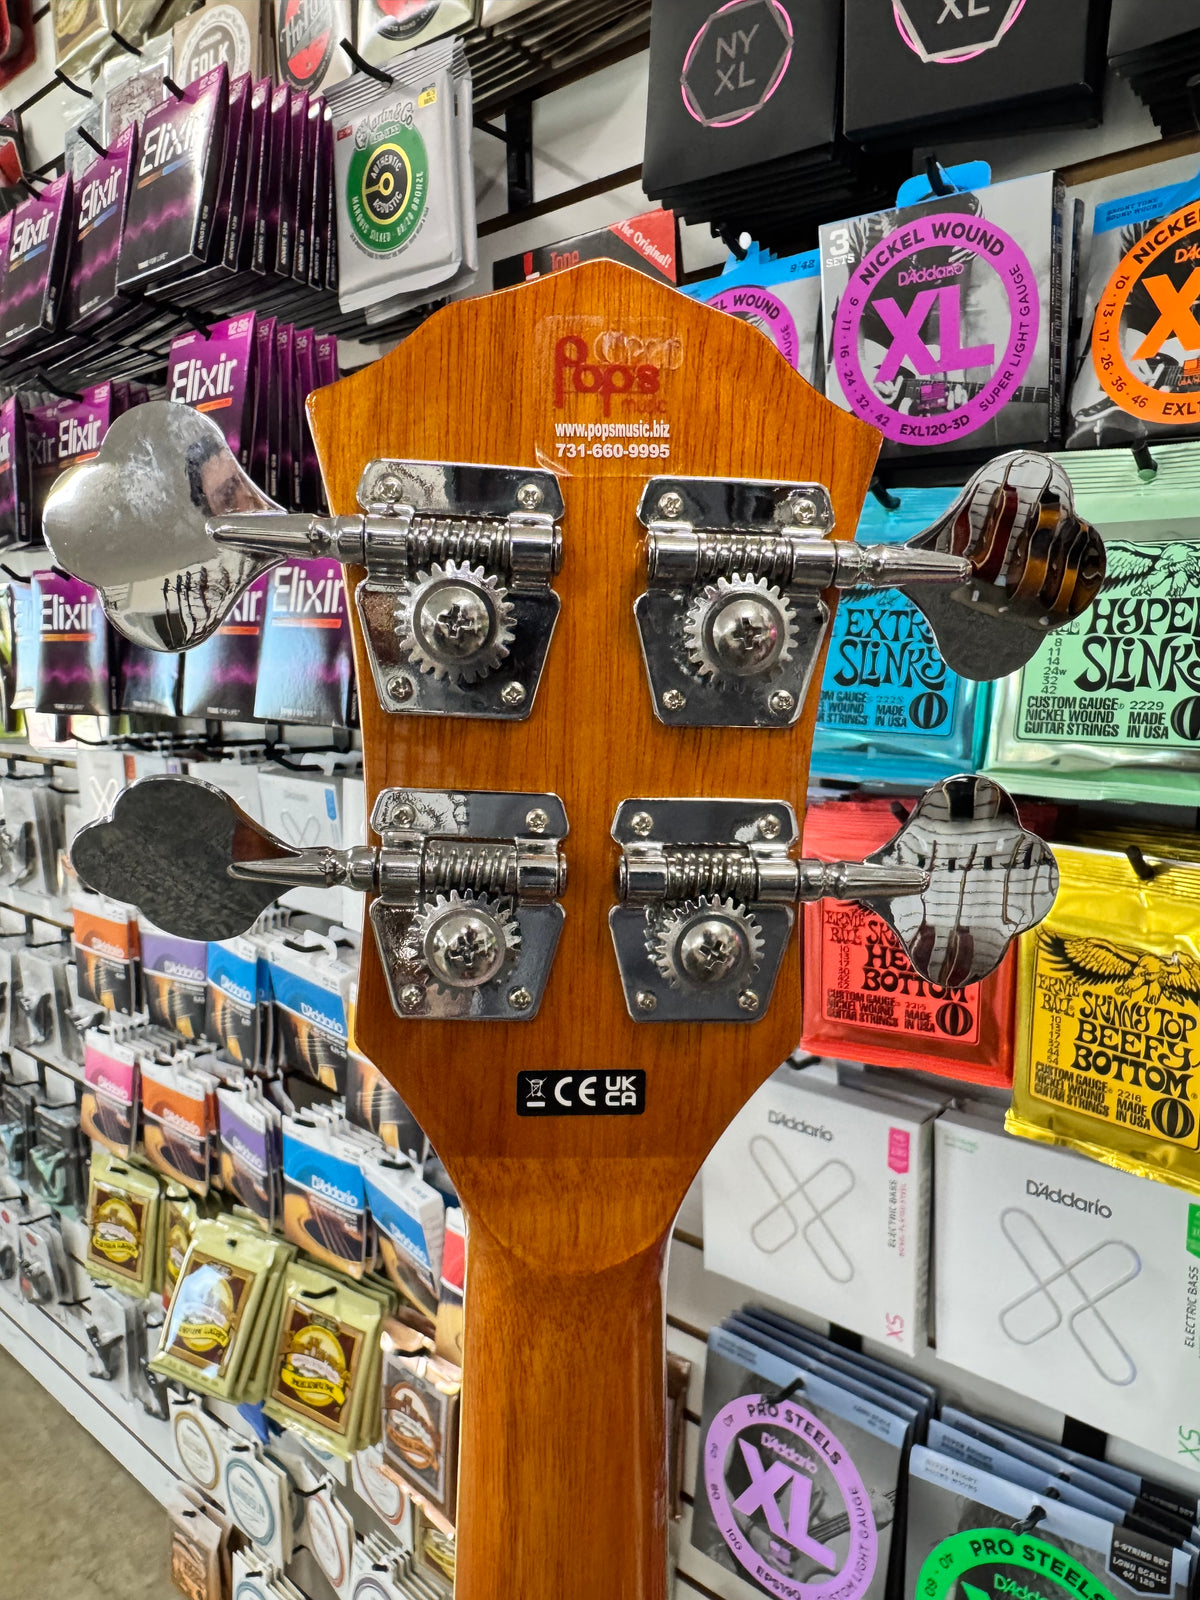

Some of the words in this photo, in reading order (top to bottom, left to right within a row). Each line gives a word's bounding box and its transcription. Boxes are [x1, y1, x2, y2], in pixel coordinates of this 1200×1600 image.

[716, 25, 759, 63] NY
[714, 62, 756, 96] XL
[371, 154, 402, 179] AUTHENTIC
[78, 166, 122, 230] Elixir
[9, 208, 54, 262] Elixir
[617, 220, 634, 237] The
[633, 232, 673, 268] Original!
[829, 228, 849, 256] 3
[1133, 208, 1200, 264] NICKE
[826, 253, 855, 268] SETS
[859, 228, 925, 285] NICKEL
[931, 221, 1005, 257] WOUND
[898, 263, 964, 287] D'Addario
[1115, 275, 1130, 290] 10
[1008, 263, 1031, 316] GAUGE
[733, 293, 780, 320] WOUND
[1103, 302, 1115, 317] 13
[871, 284, 995, 383] XL
[1013, 321, 1030, 368] LIGHT
[1099, 329, 1109, 343] 17
[840, 344, 850, 358] 16
[1101, 353, 1114, 371] 26
[171, 353, 238, 404] Elixir
[555, 335, 660, 418] Pops
[844, 371, 857, 386] 24
[1111, 376, 1127, 392] 36
[855, 394, 869, 410] 32
[979, 370, 1014, 412] SUPER
[1132, 395, 1148, 408] 46
[555, 420, 670, 442] www.popsmusic.biz
[875, 413, 890, 427] 42
[899, 414, 970, 436] EXL120-3D
[59, 414, 101, 458] Elixir
[555, 443, 670, 459] 731-660-9995
[272, 566, 344, 614] Elixir
[41, 594, 97, 631] Elixir
[845, 608, 934, 644] EXTR
[1048, 648, 1061, 656] 11
[1055, 638, 1062, 647] 8
[1047, 657, 1060, 666] 14
[1041, 686, 1057, 695] 42
[1042, 676, 1058, 685] 32
[829, 701, 865, 713] WOUND
[837, 691, 867, 703] GAUGE
[1027, 696, 1076, 709] CUSTOM
[1078, 697, 1119, 711] GAUGE
[1129, 700, 1164, 711] 2229
[826, 713, 869, 725] STRINGS
[876, 705, 904, 716] MADE
[1025, 709, 1066, 722] NICKEL
[1069, 710, 1115, 723] WOUND
[1128, 712, 1166, 725] MADE
[875, 716, 887, 726] IN
[887, 717, 907, 728] USA
[1024, 722, 1065, 735] GUITAR
[1066, 723, 1120, 738] STRINGS
[1127, 725, 1142, 738] IN
[1143, 725, 1169, 739] USA
[824, 910, 866, 927] ERNIE
[862, 966, 968, 1003] BOTTOM
[1036, 974, 1081, 998] ERNIE
[828, 988, 865, 1001] CUSTOM
[866, 994, 896, 1007] GAUGE
[859, 1013, 899, 1027] STRINGS
[860, 1002, 894, 1017] WOUND
[905, 1009, 932, 1021] MADE
[904, 1019, 916, 1030] IN
[917, 1020, 935, 1033] USA
[1154, 1006, 1197, 1043] TOP
[1075, 1018, 1200, 1071] BEEFY
[1035, 1061, 1074, 1083] CUSTOM
[1076, 1073, 1108, 1094] GAUGE
[1071, 1042, 1194, 1101] BOTTOM
[554, 1076, 597, 1107] CE
[605, 1076, 636, 1091] UK
[605, 1092, 636, 1106] CA
[1067, 1084, 1106, 1104] WOUND
[1067, 1092, 1110, 1117] STRINGS
[1117, 1098, 1147, 1116] MADE
[768, 1109, 834, 1142] D'Addario
[1115, 1109, 1128, 1122] IN
[1129, 1113, 1151, 1130] USA
[1026, 1178, 1112, 1219] D'Addario
[1188, 1265, 1199, 1294] BASS
[885, 1313, 904, 1342] XS
[1184, 1297, 1197, 1348] ELECTRIC
[747, 1402, 779, 1418] PRO
[784, 1408, 842, 1465] STEELS
[732, 1437, 836, 1571] XL
[968, 1538, 1013, 1557] PRO
[1022, 1544, 1108, 1600] STEELS
